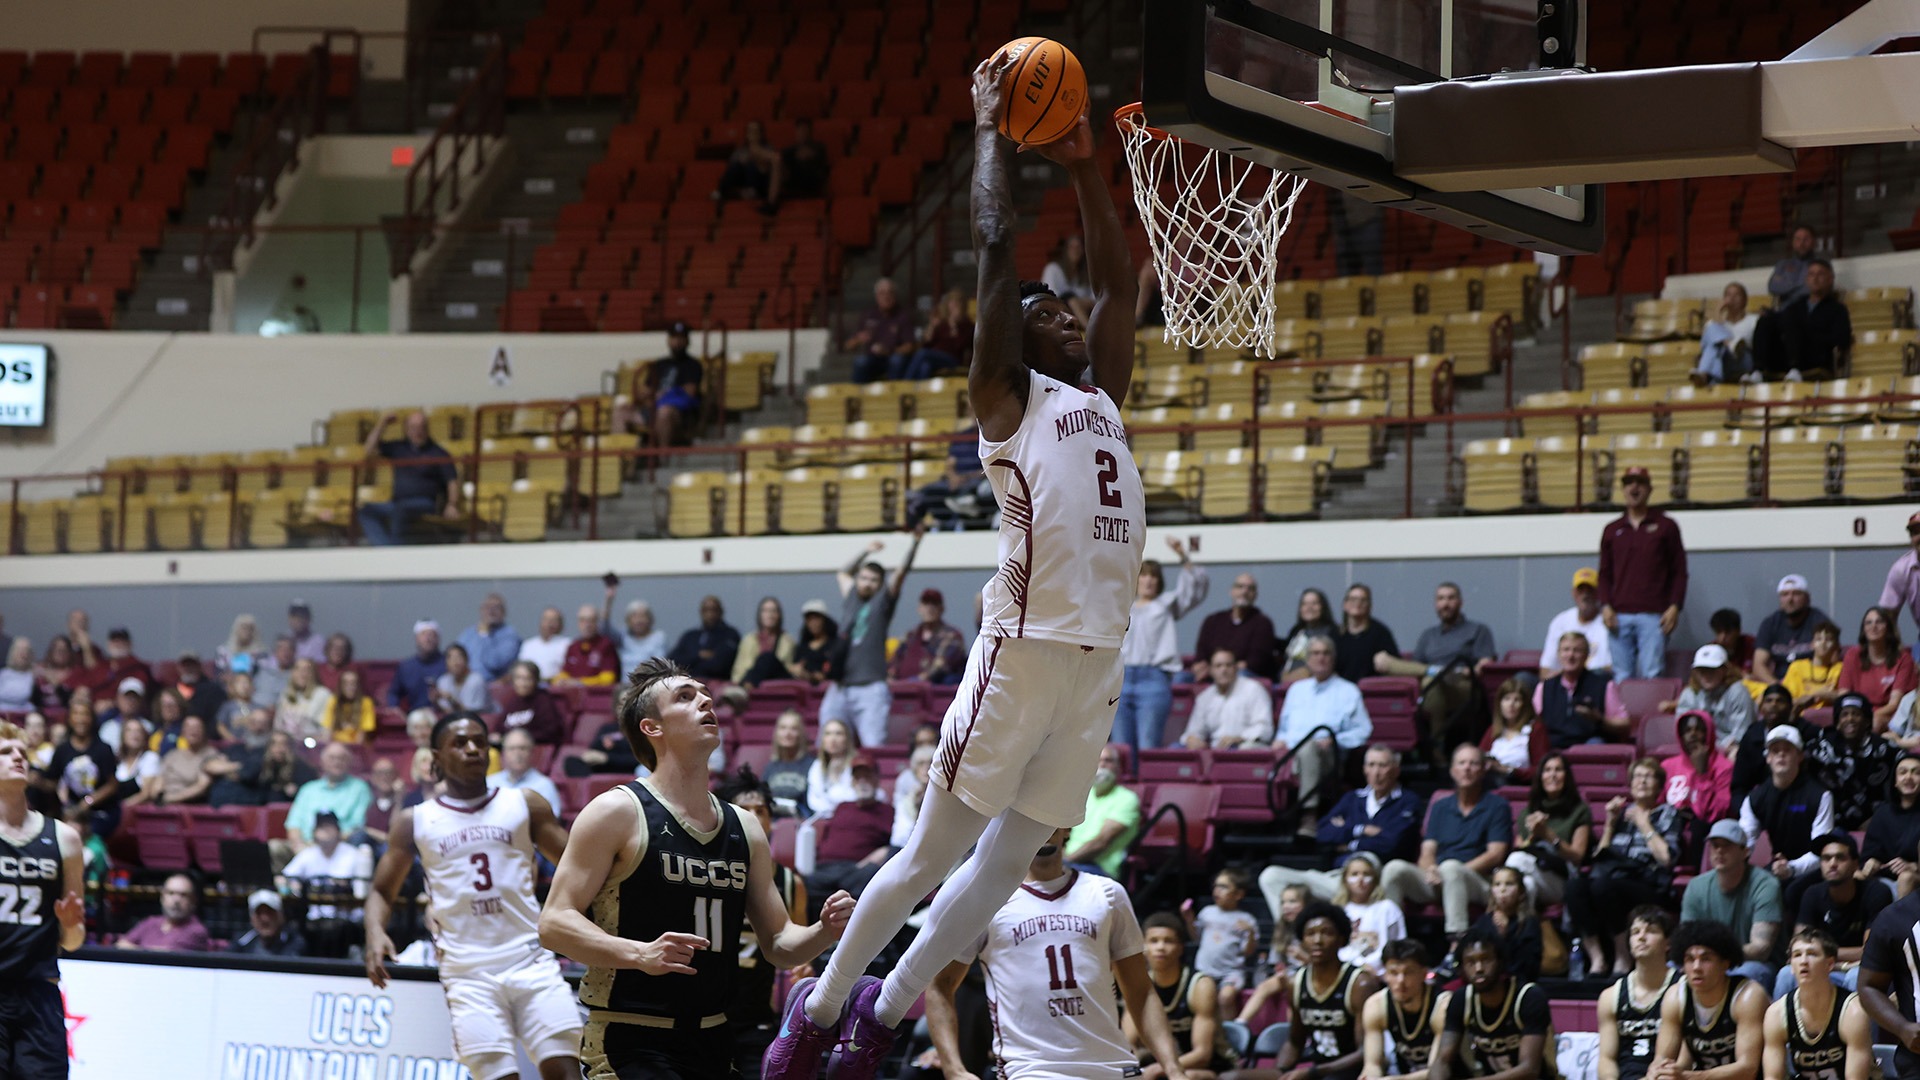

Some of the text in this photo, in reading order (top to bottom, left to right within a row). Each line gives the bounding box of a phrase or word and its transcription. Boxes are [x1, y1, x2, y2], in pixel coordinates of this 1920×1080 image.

[1095, 449, 1123, 508] 2
[1093, 515, 1130, 544] STATE
[438, 825, 513, 857] MIDWESTERN
[470, 852, 494, 892] 3
[660, 850, 748, 891] UCCS
[0, 884, 43, 926] 22
[693, 896, 723, 953] 11
[1011, 914, 1099, 947] MIDWESTERN
[1045, 944, 1078, 990] 11
[309, 991, 395, 1048] UCCS
[1048, 996, 1085, 1017] STATE
[221, 1042, 378, 1080] MOUNTAIN
